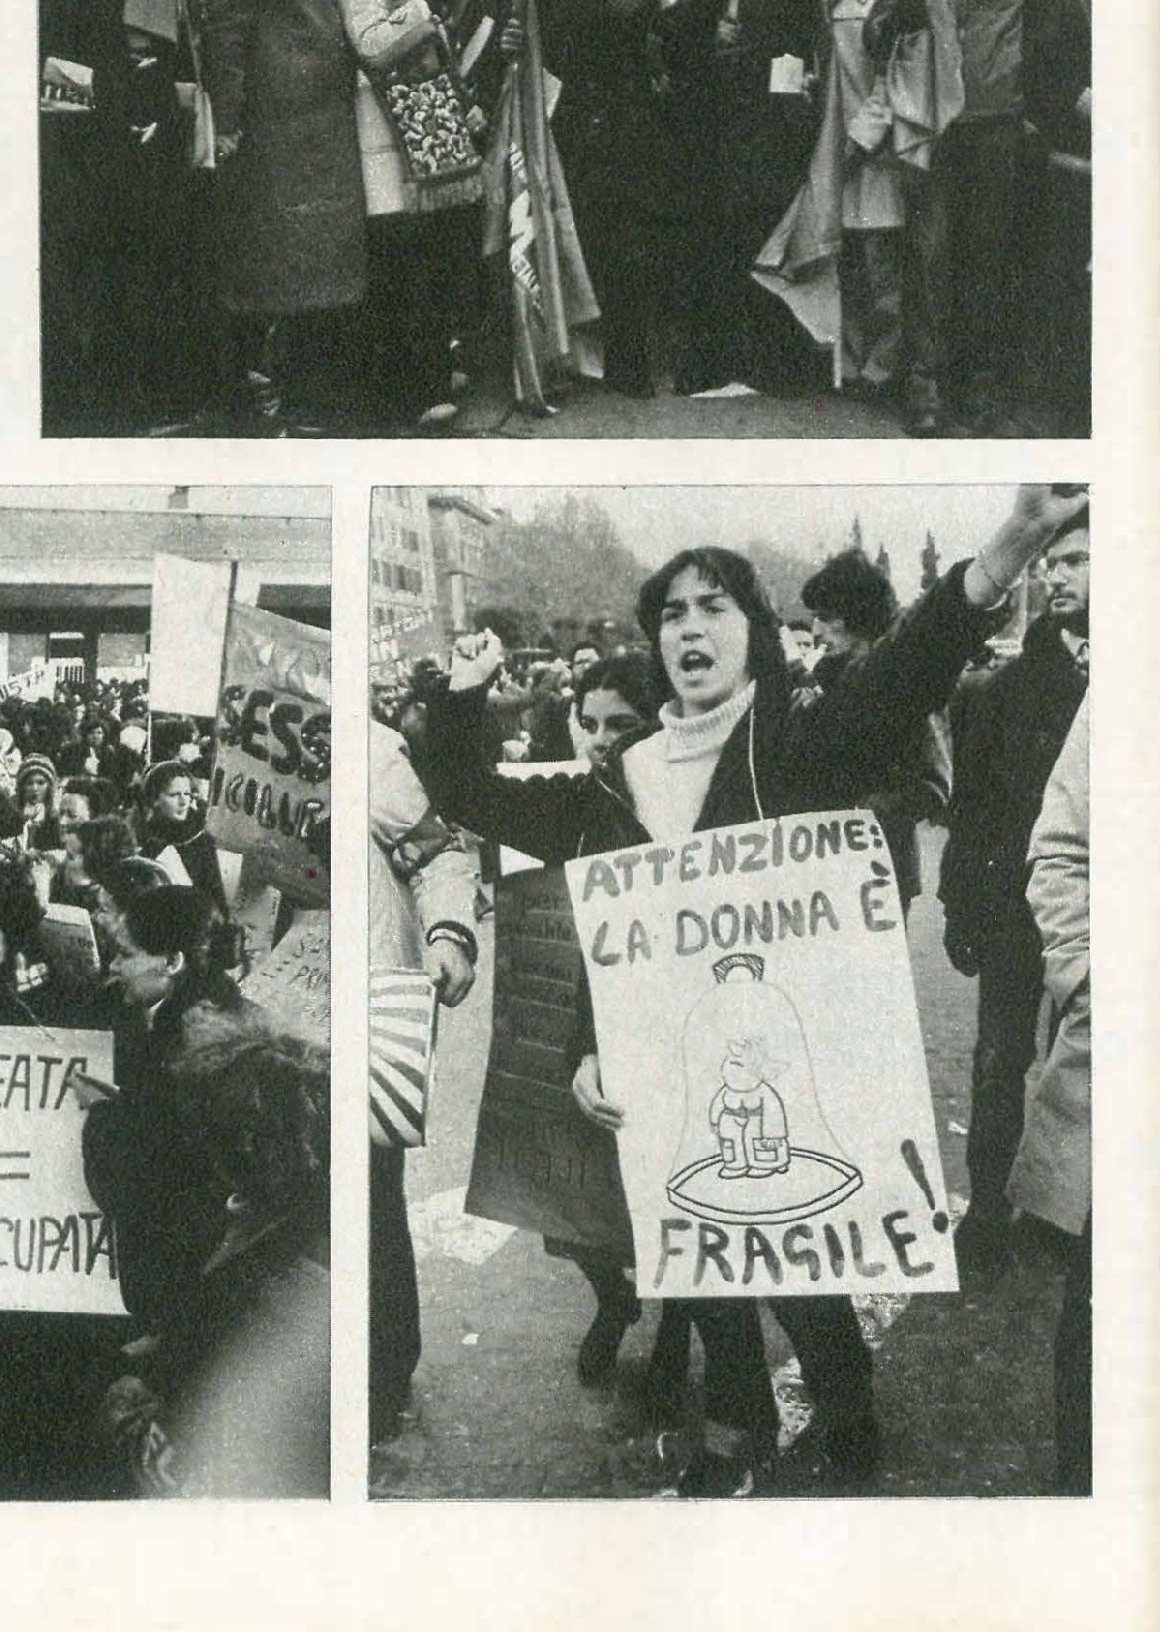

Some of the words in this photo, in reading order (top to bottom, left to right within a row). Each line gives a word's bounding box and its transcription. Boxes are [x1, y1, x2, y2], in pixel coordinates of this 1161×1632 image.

[581, 817, 884, 903] ATTENZIONE:
[590, 917, 652, 967] LA
[675, 889, 840, 957] DONNA
[859, 858, 898, 933] È
